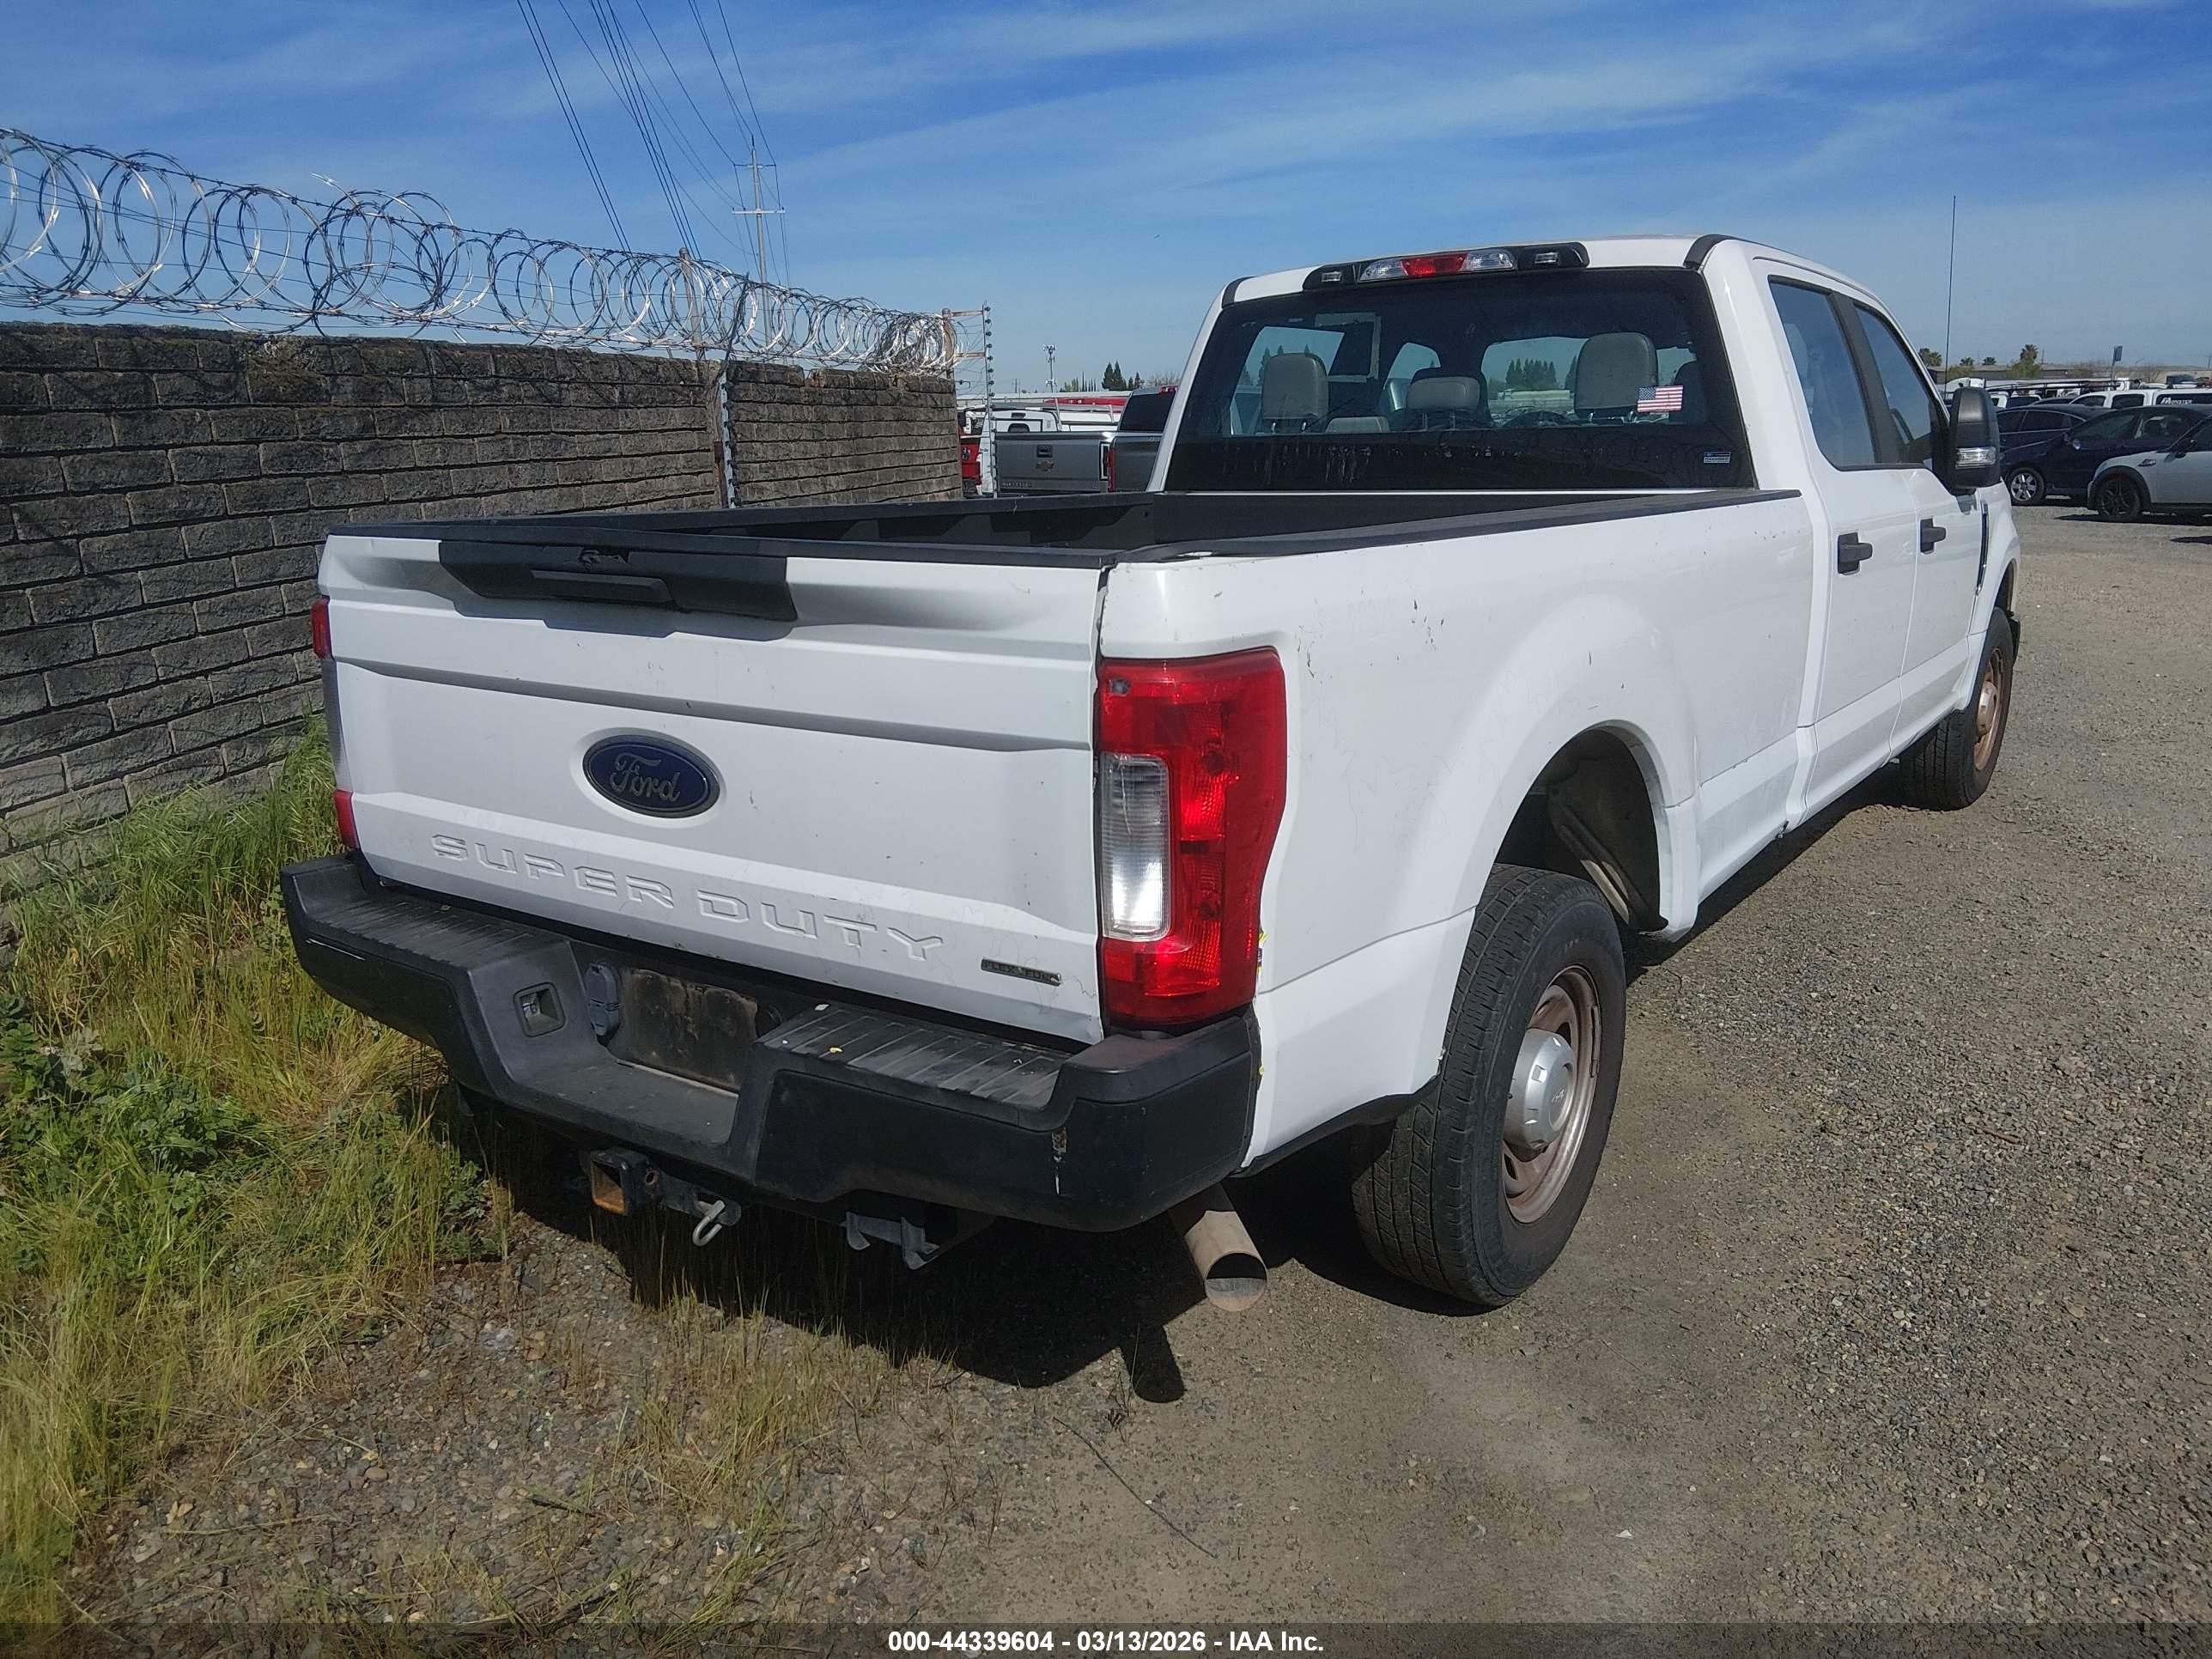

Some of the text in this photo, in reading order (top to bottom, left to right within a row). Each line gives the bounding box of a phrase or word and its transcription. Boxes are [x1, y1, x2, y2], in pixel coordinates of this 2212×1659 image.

[610, 752, 681, 802] Ford
[431, 833, 943, 962] SUPER DUTY
